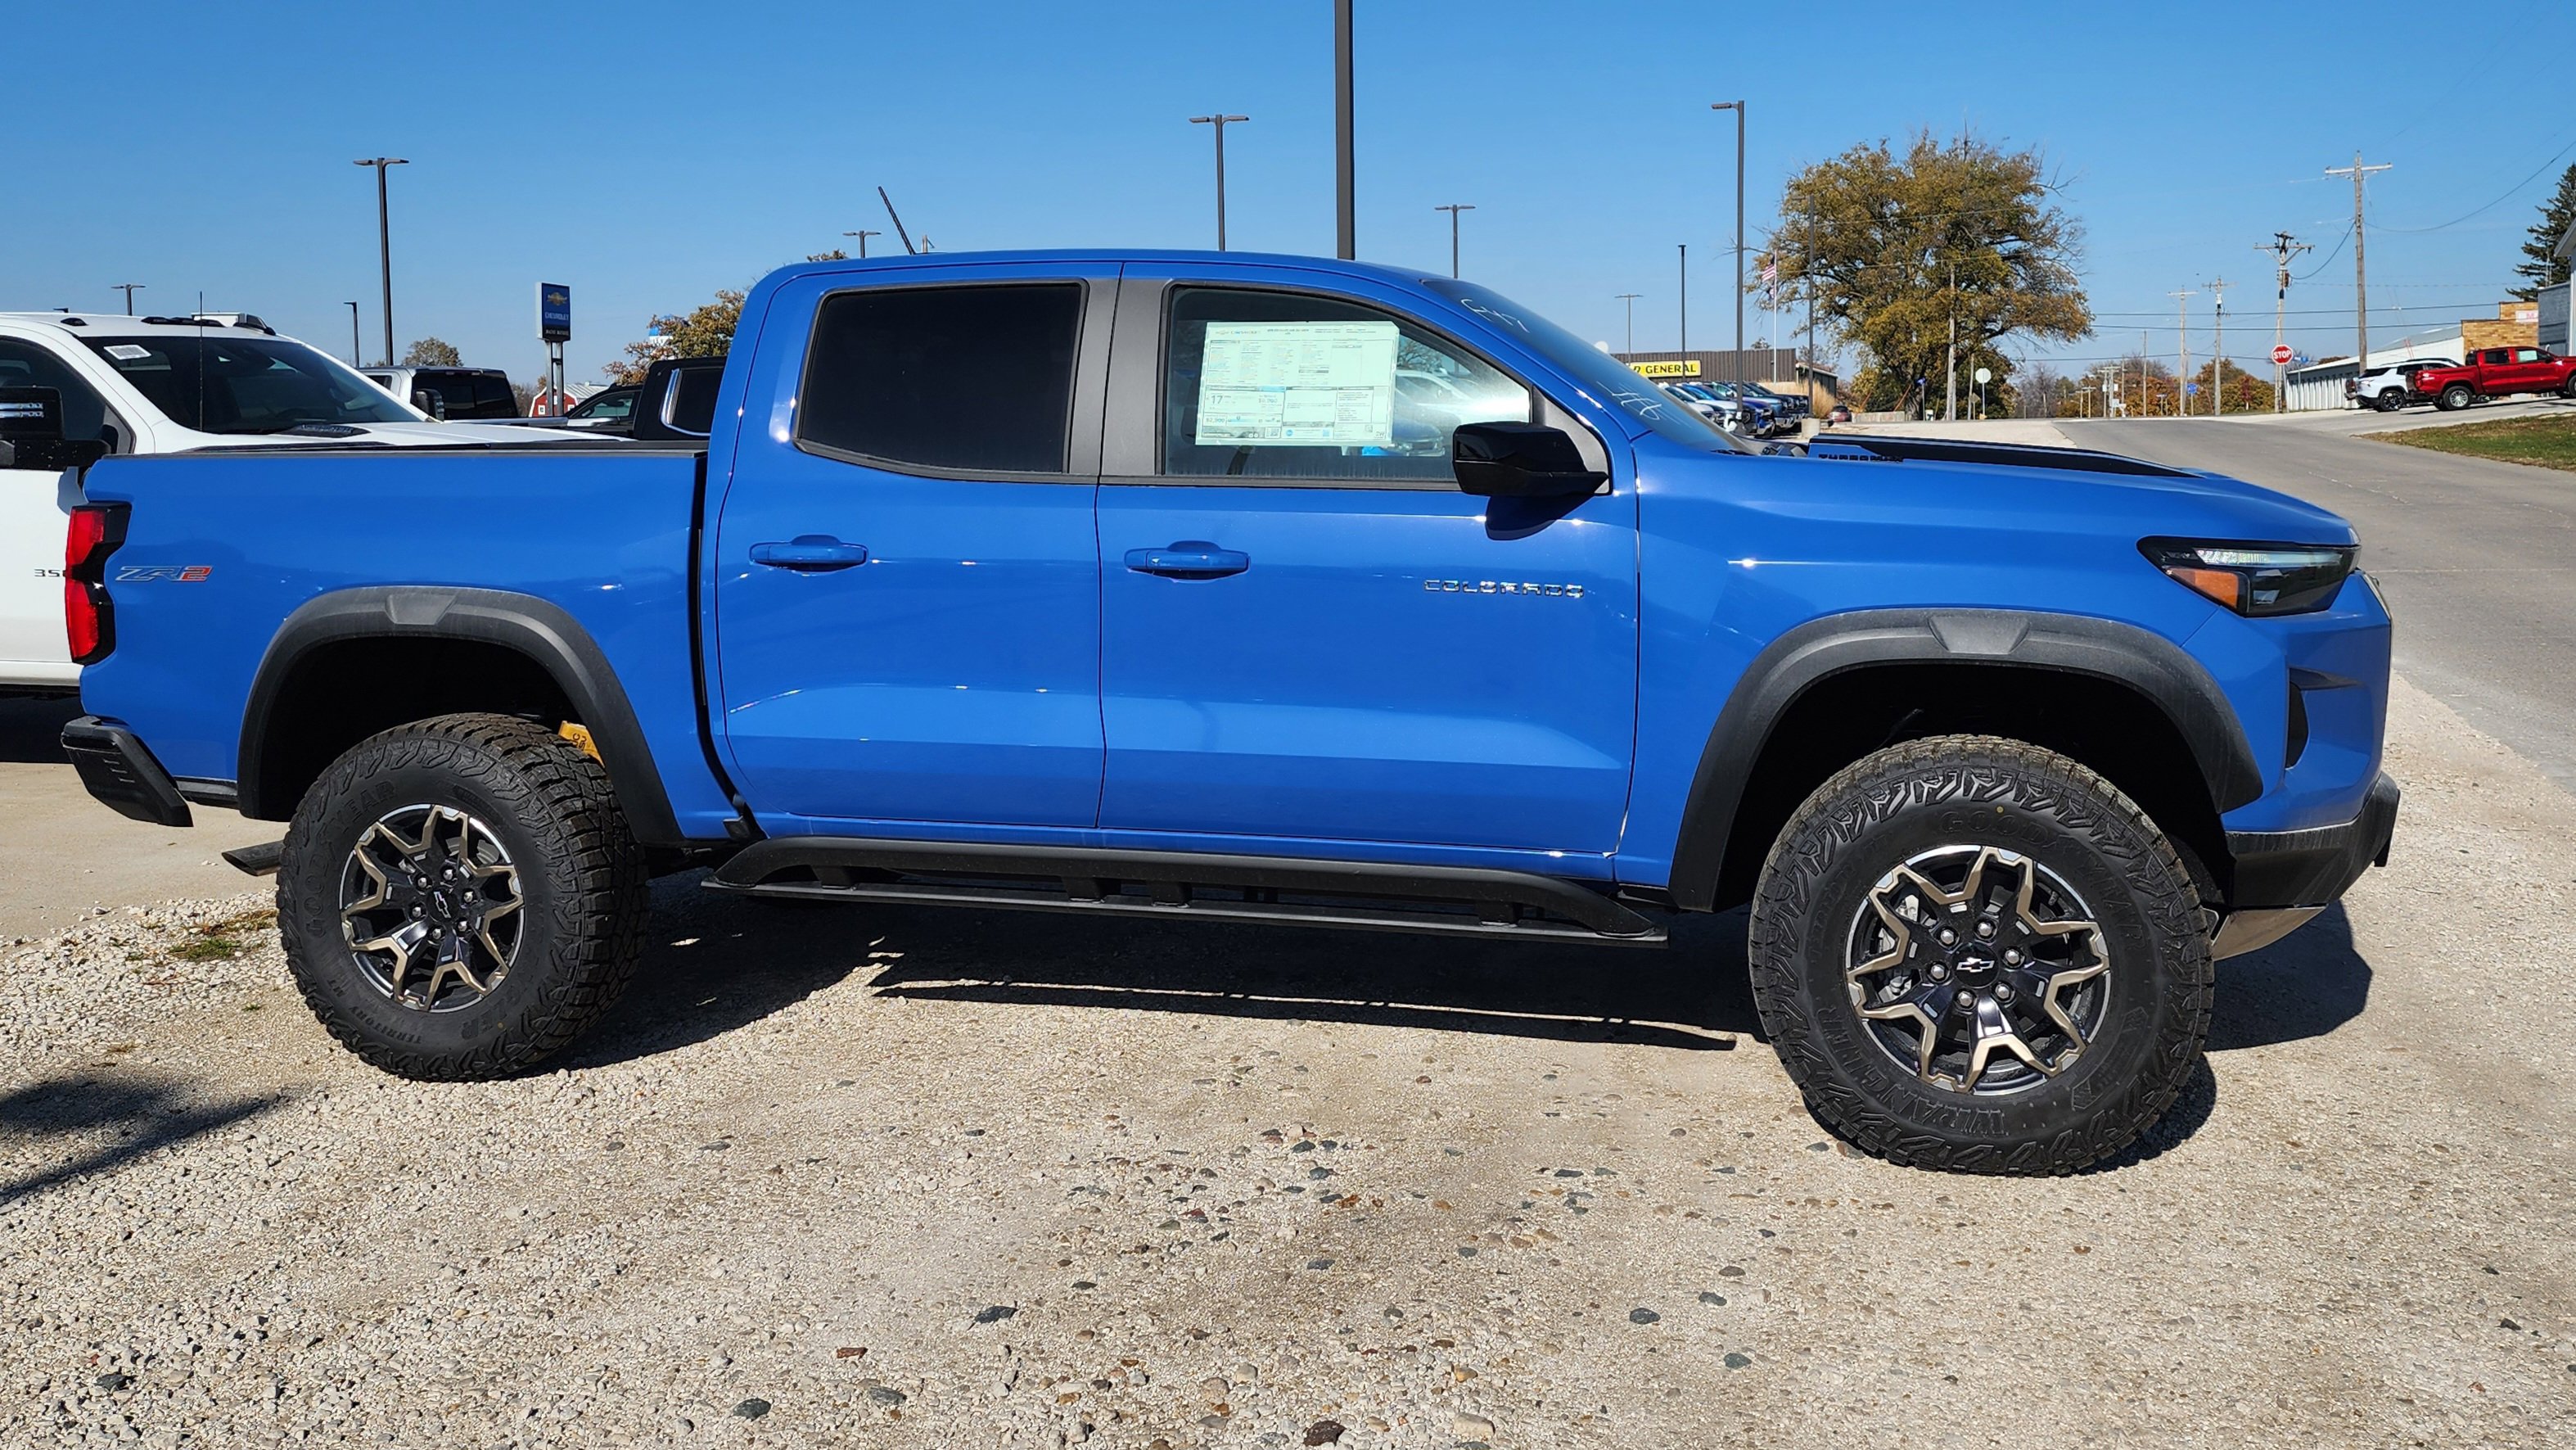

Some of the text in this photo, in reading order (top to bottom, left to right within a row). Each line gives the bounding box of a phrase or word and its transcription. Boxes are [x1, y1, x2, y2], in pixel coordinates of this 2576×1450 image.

[2273, 350, 2291, 359] STOP
[1645, 364, 1697, 374] GENERAL
[115, 566, 214, 583] ZR2
[1423, 579, 1585, 599] COLORADO
[348, 1005, 422, 1044] TERRITORY
[1816, 1008, 2010, 1136] WRANGLER
